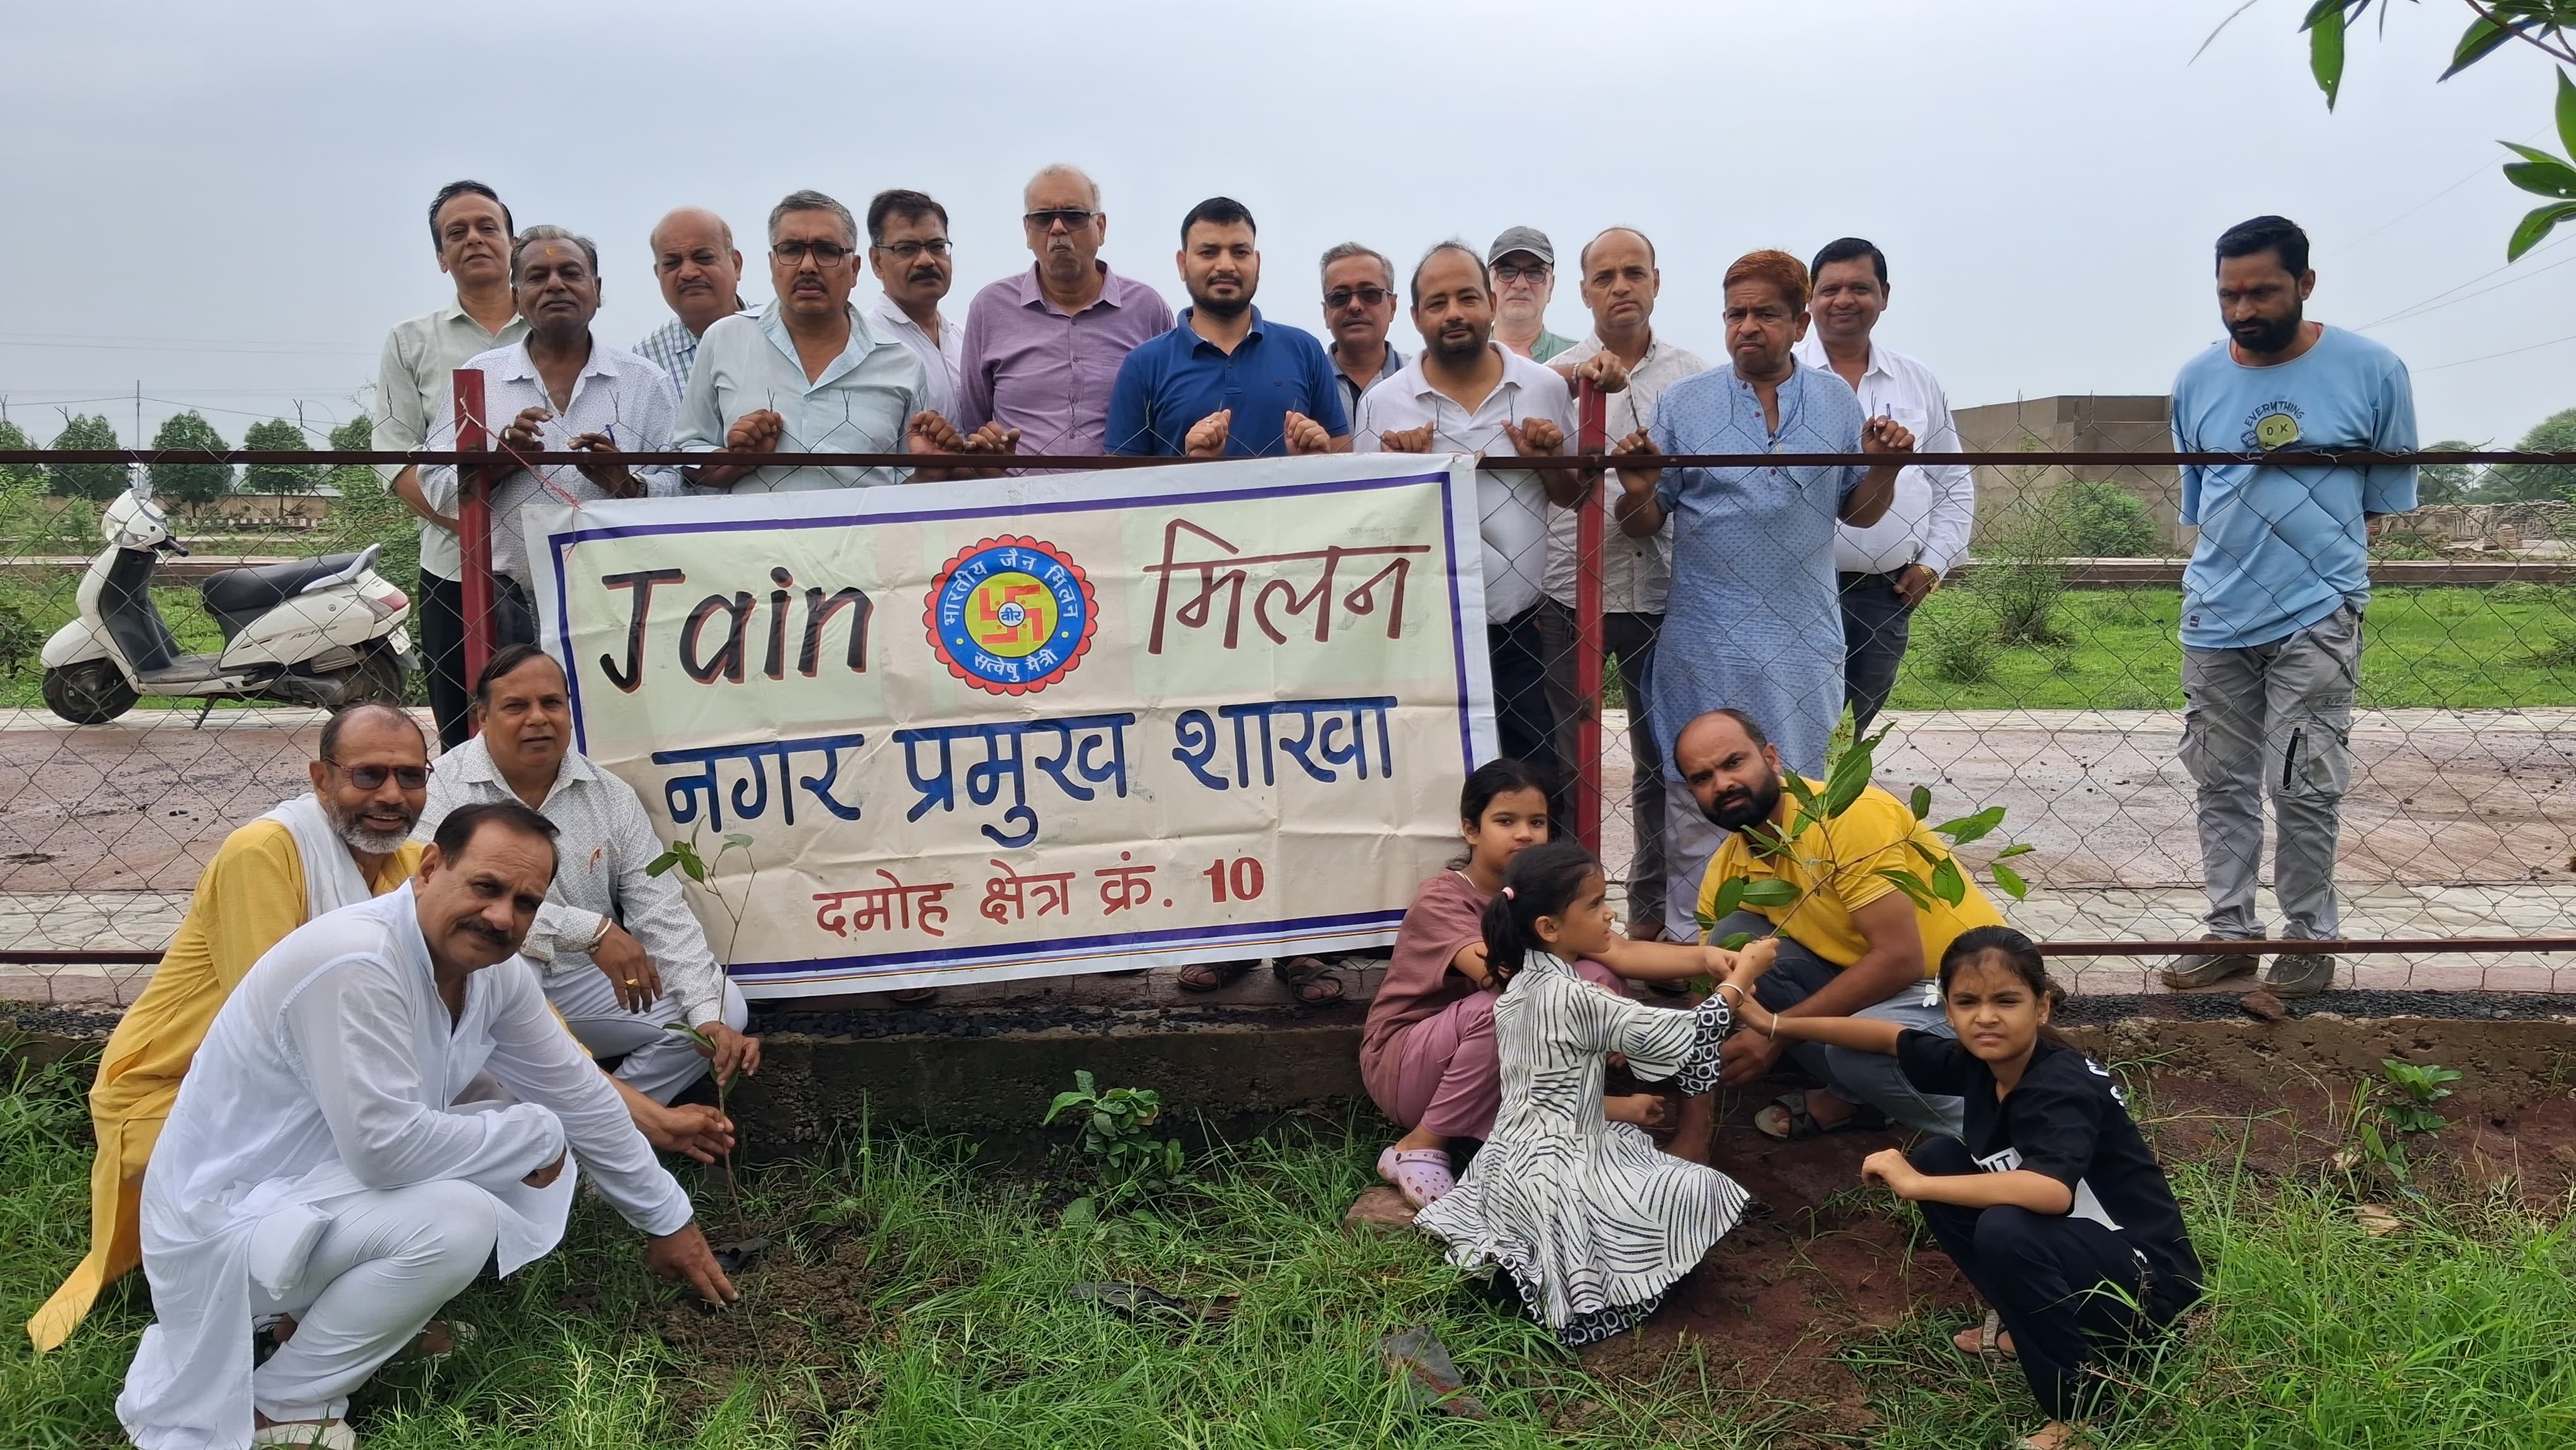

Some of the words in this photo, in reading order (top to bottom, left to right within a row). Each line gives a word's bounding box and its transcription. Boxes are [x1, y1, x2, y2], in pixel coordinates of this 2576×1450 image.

[2244, 400, 2305, 427] EVERYTHING
[944, 560, 987, 626] भारतीय
[998, 548, 1037, 571] जैन
[1044, 565, 1078, 618] मिलन
[1001, 607, 1022, 622] वीर
[1142, 518, 1431, 654] मिलन
[600, 566, 874, 693] Jain
[1025, 649, 1058, 672] मैत्री
[651, 733, 865, 833] नगर
[891, 714, 1135, 848] प्रमुख
[1172, 696, 1398, 791] शाखा
[813, 868, 954, 937] दमोह
[981, 859, 1076, 925] क्षेत्र
[1203, 856, 1265, 903] 10
